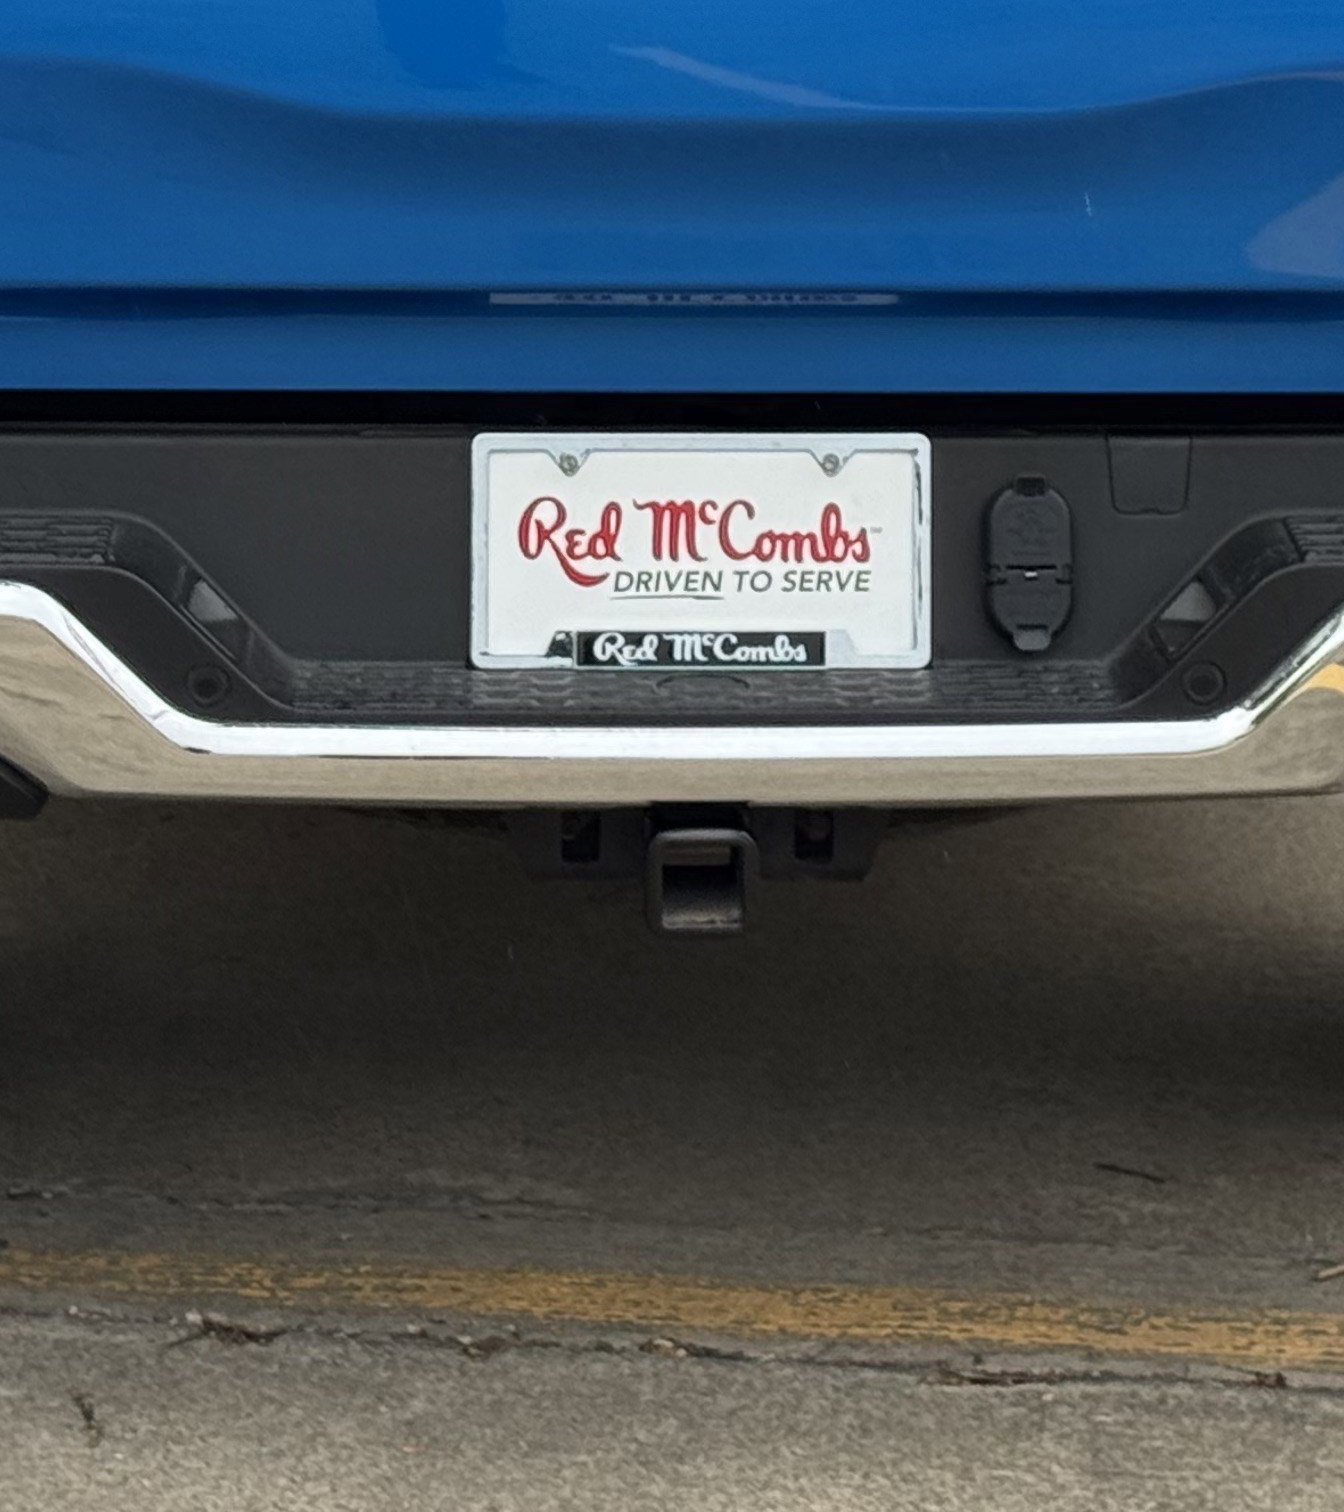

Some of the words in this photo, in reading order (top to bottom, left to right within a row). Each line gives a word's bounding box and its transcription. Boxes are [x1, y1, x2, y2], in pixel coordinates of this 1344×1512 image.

[517, 496, 623, 588] Red
[632, 498, 872, 564] McCombs
[613, 569, 725, 593] DRIVEN
[735, 569, 774, 593] TO
[780, 569, 873, 593] SERVE
[592, 632, 660, 666] Red
[662, 633, 808, 663] McCombs
